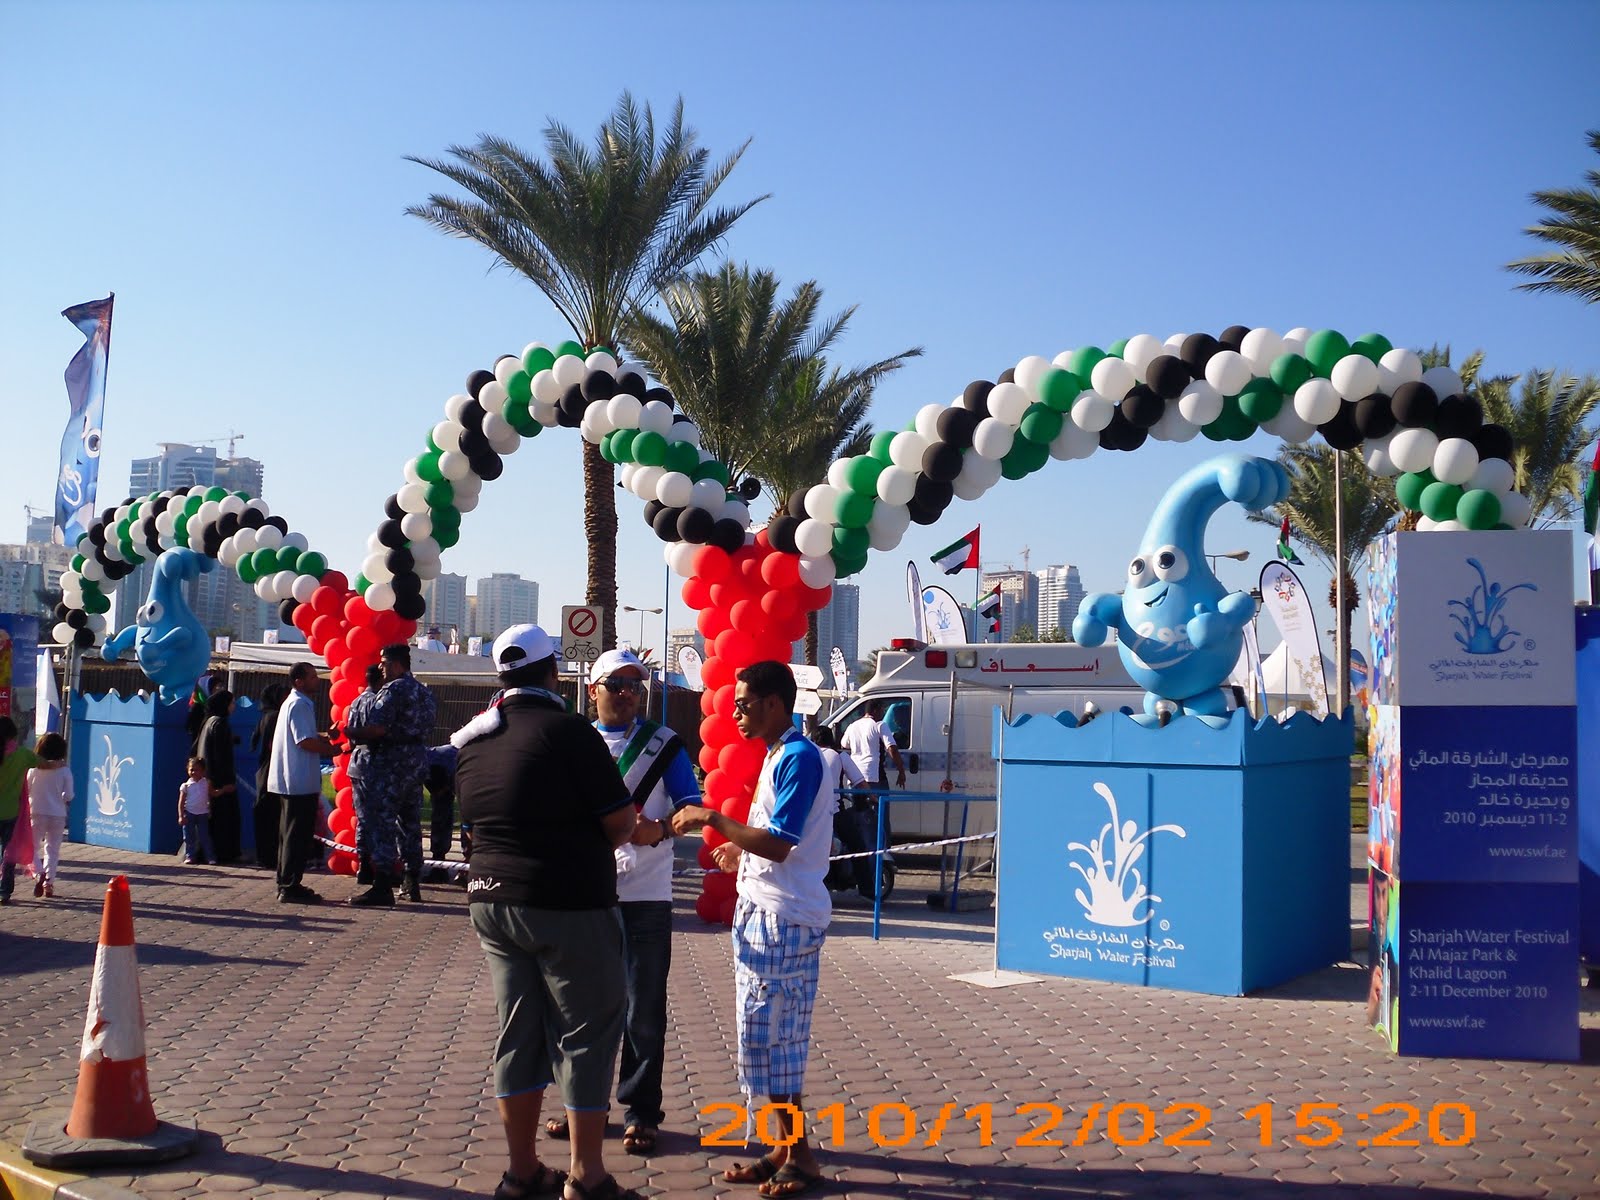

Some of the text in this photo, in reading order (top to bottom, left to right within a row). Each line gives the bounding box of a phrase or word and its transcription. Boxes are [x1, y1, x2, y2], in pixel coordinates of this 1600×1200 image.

[1409, 750, 1569, 770] مهرجان الشارقة المائي
[1469, 773, 1569, 789] حديقة المجاز
[1478, 793, 1510, 806] خالد
[1444, 811, 1476, 825] 2010
[1480, 814, 1535, 827] ديسمبر
[1489, 845, 1567, 858] www.swf.ae
[1409, 929, 1570, 946] Sharjah Water Festival
[1049, 943, 1176, 969] Sharjah Water Festival
[1408, 948, 1518, 963] Al Majaz Park &
[1409, 966, 1507, 983] Khalid Lagoon
[1409, 984, 1548, 999] 2-11 December 2010
[1409, 1015, 1486, 1029] www.swf.ae
